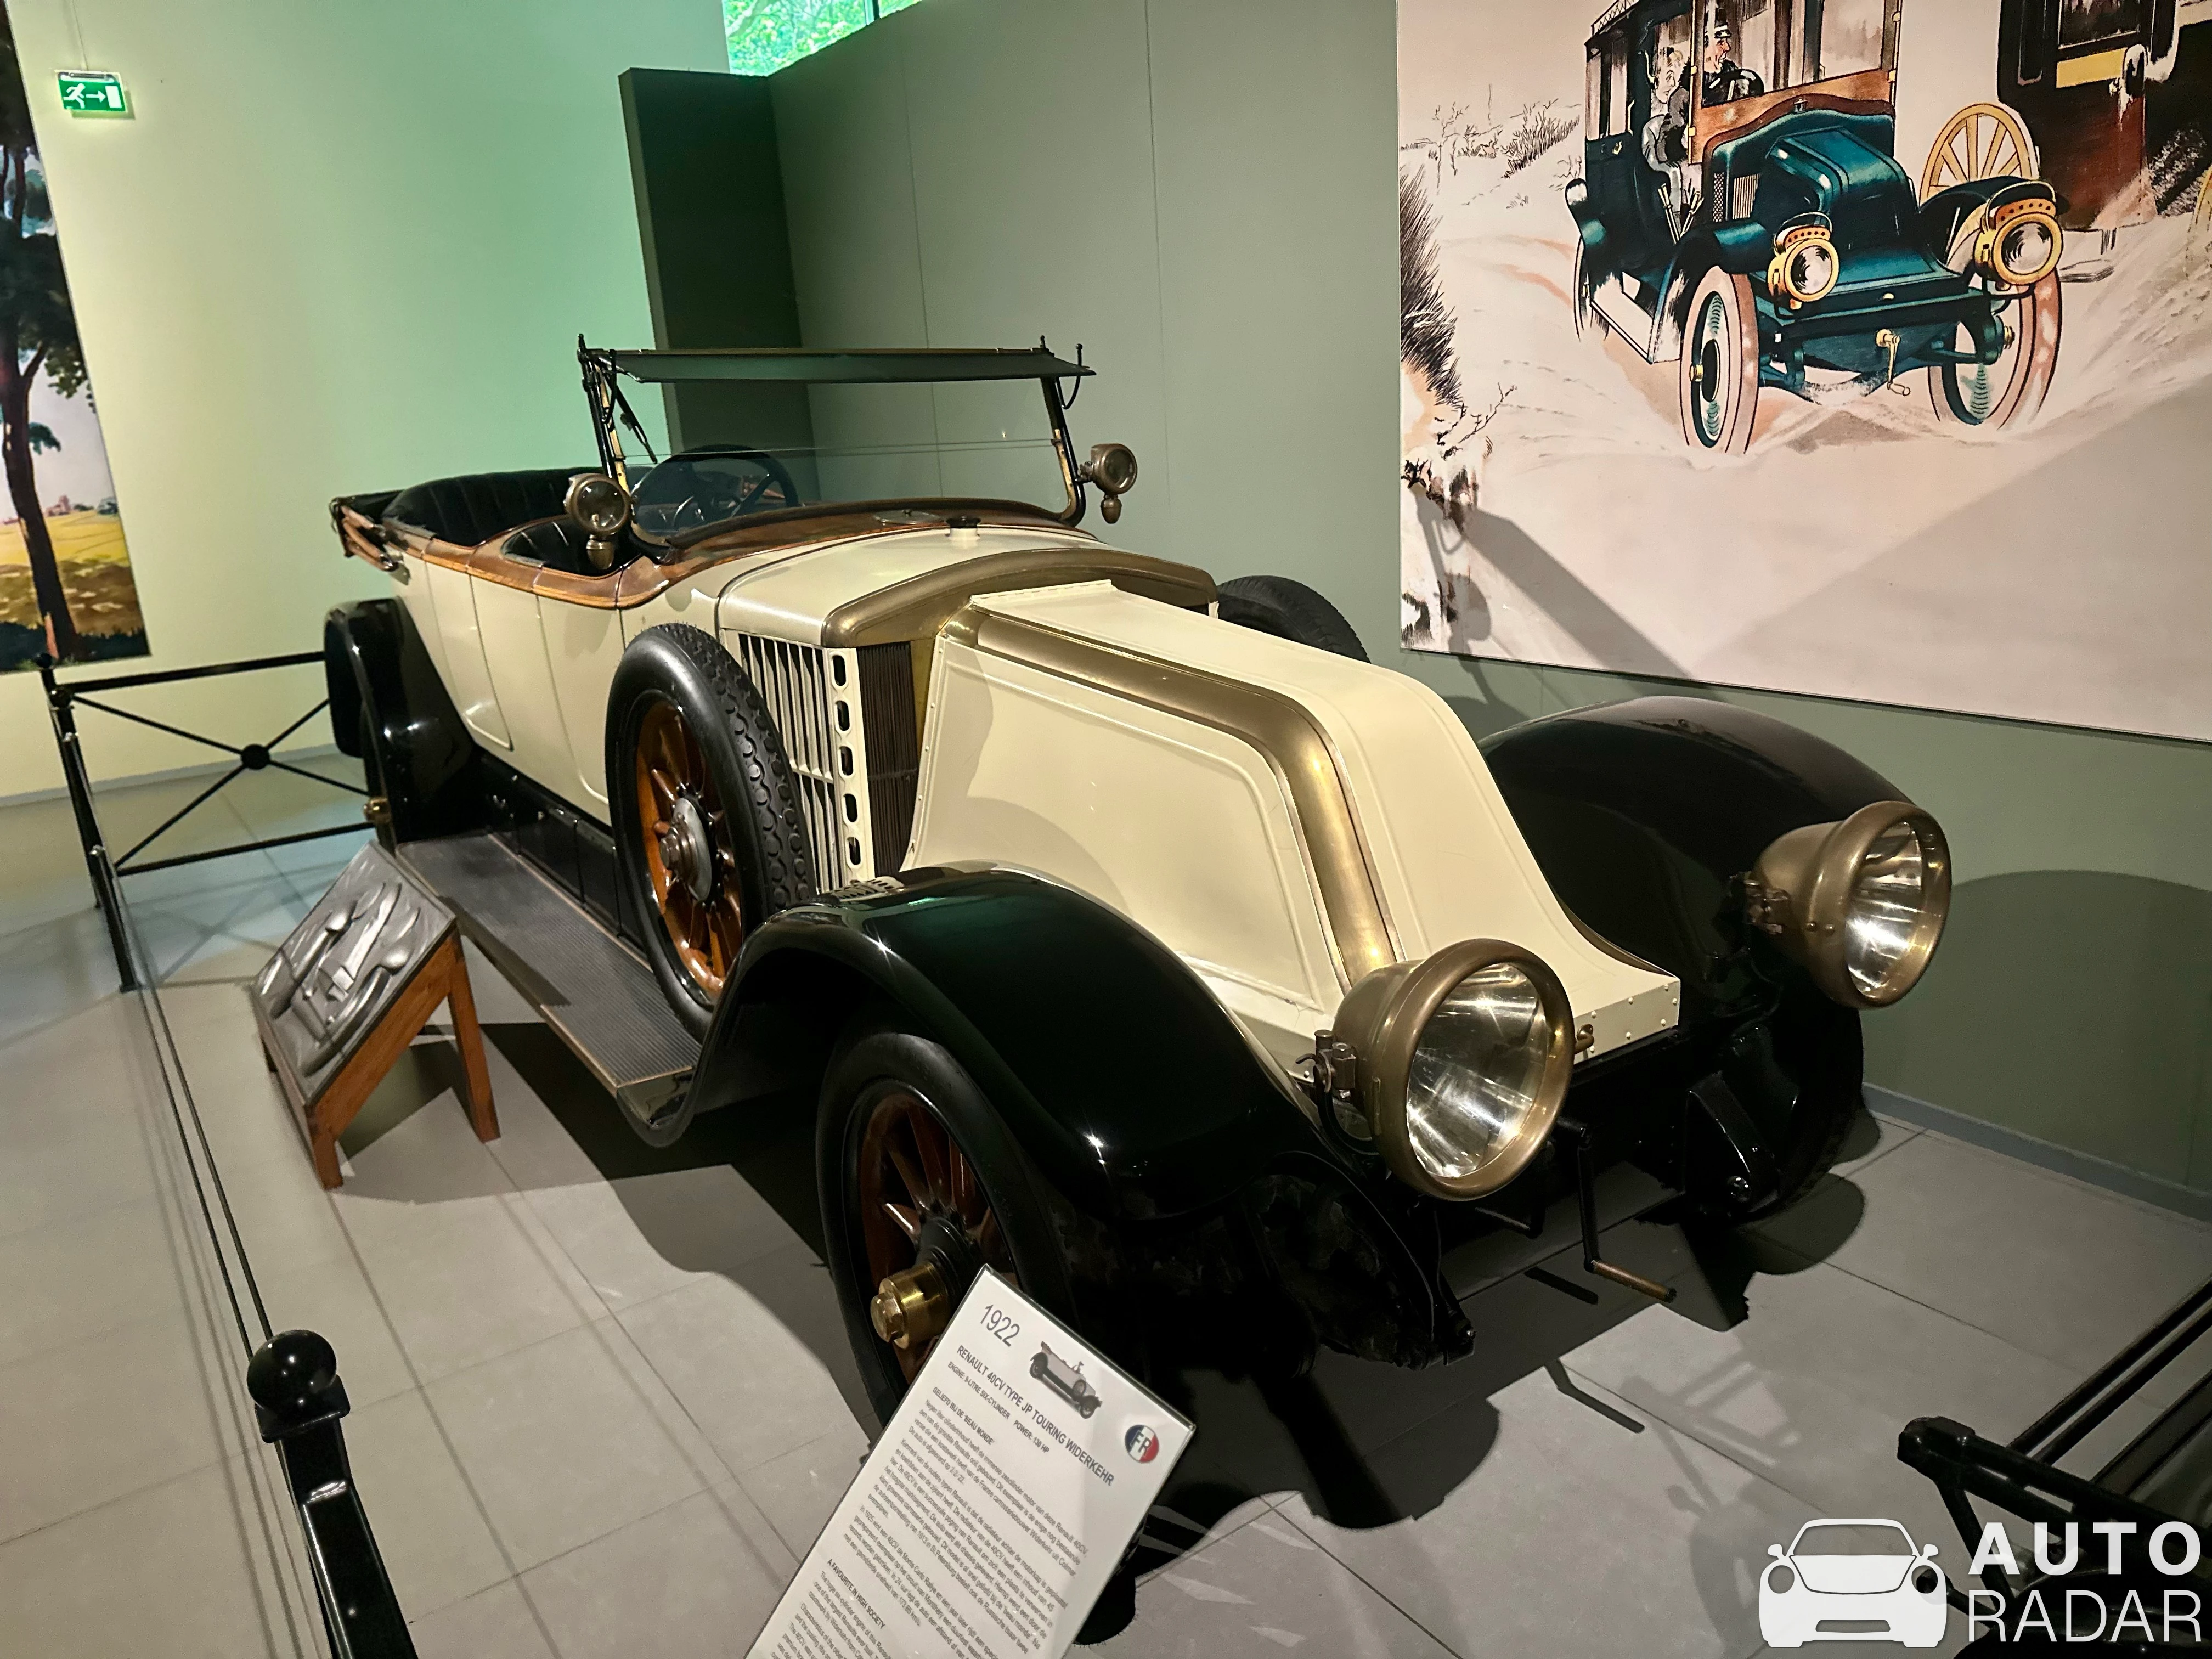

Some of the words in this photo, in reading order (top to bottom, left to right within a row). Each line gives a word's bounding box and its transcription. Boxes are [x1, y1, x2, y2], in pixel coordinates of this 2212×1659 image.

[981, 1305, 1020, 1347] 1922
[933, 1386, 951, 1406] GELIEFD
[949, 1402, 958, 1412] BIJ
[956, 1408, 965, 1418] DE
[947, 1361, 965, 1379] ENGINE:
[964, 1376, 981, 1393] 9-LITRE
[980, 1390, 1011, 1419] SIX-CYLINDER
[956, 1345, 989, 1375] RENAULT
[986, 1372, 1006, 1391] 40CV
[1003, 1385, 1024, 1407] TYPE
[1021, 1402, 1033, 1414] JP
[1032, 1409, 1066, 1444] TOURING
[1065, 1438, 1114, 1486] WIDERKEHR
[1013, 1419, 1032, 1440] POWER:
[1041, 1444, 1049, 1453] HP
[1131, 1431, 1153, 1457] FR
[831, 1562, 854, 1592] FAVOURITE
[851, 1587, 859, 1597] IN
[856, 1593, 868, 1609] HIGH
[866, 1605, 885, 1629] SOCIETY
